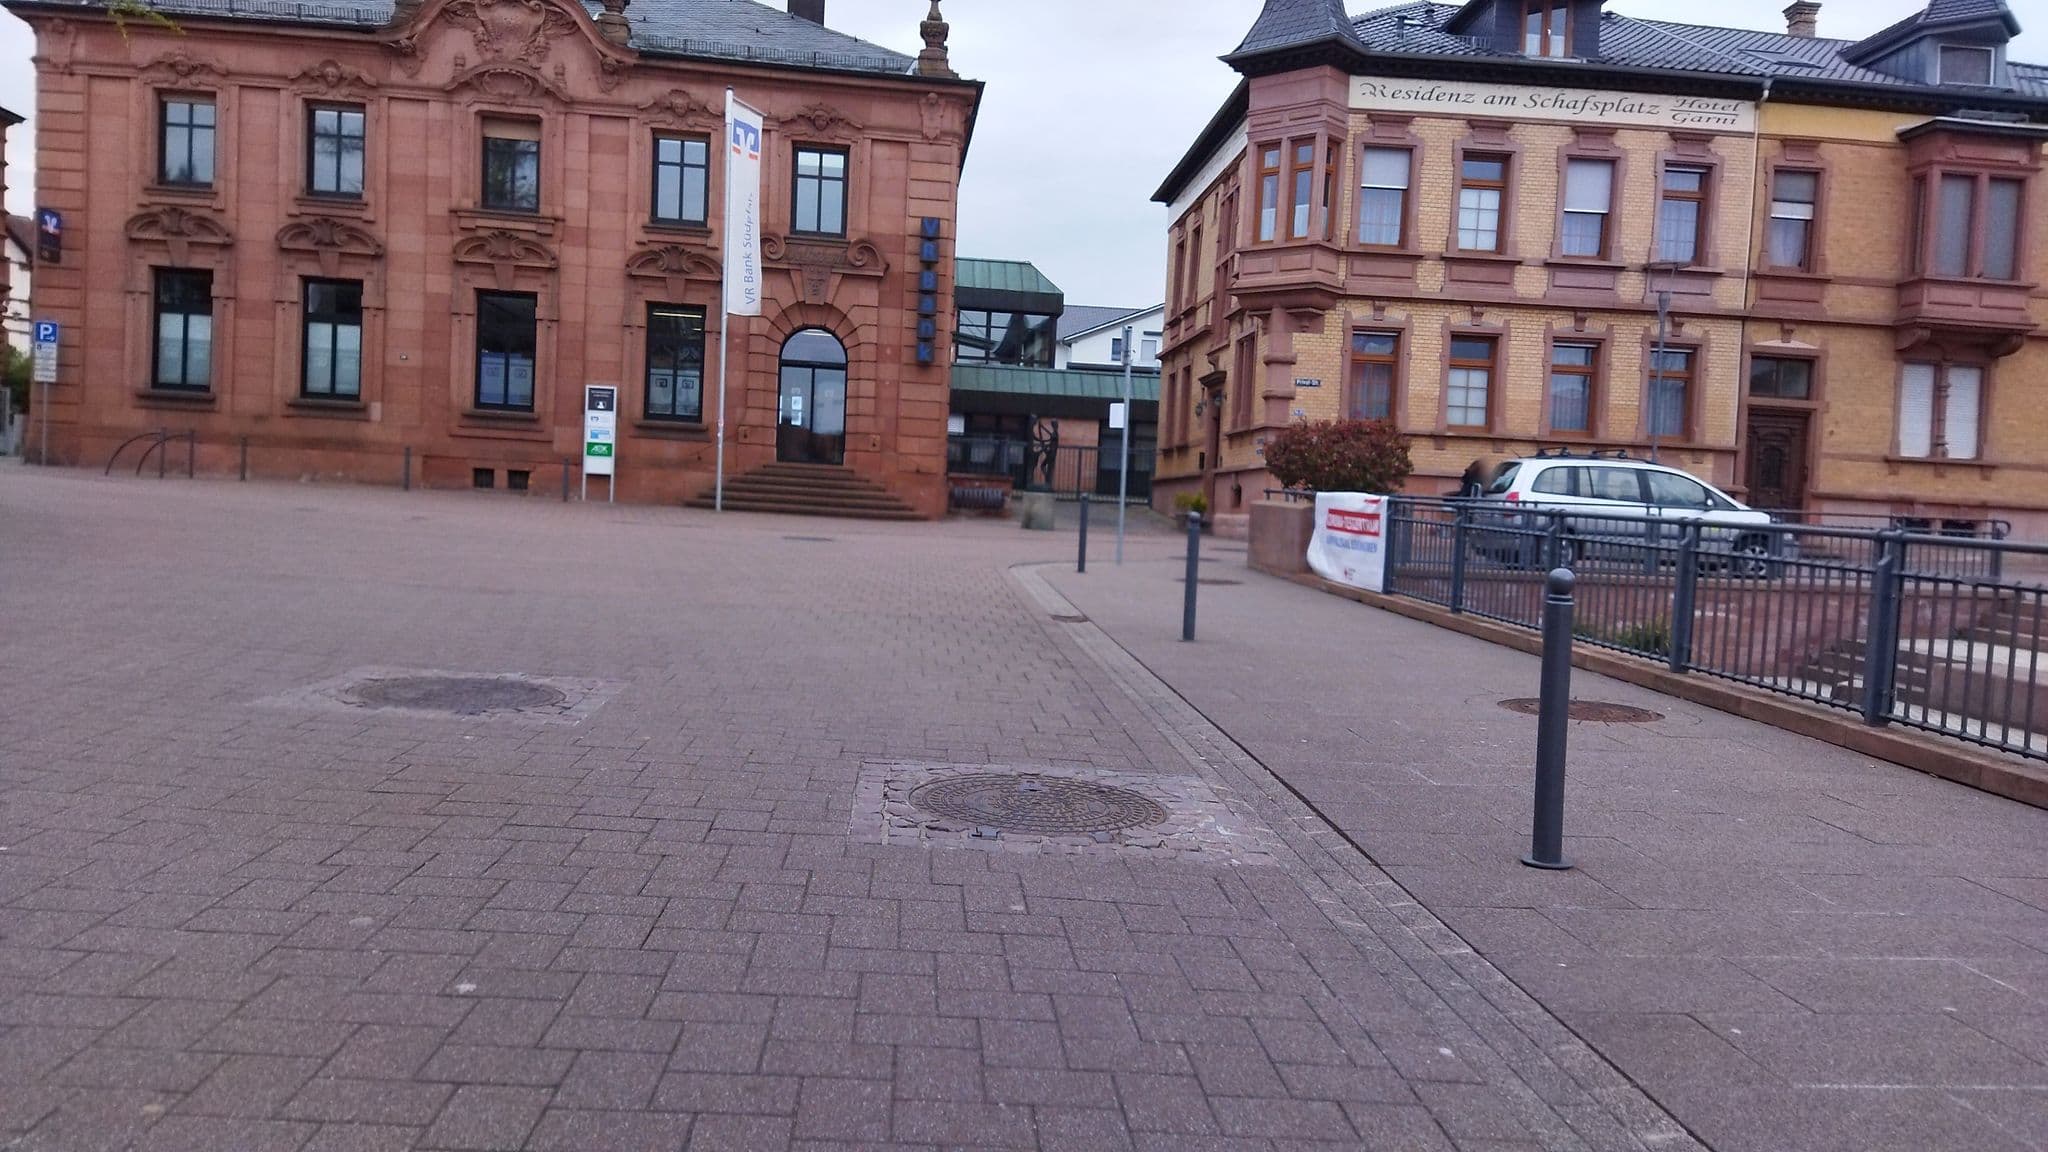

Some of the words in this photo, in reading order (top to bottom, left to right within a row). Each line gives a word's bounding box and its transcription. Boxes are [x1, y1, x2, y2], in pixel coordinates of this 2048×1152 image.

[1359, 82, 1476, 104] Residenz
[1483, 94, 1518, 106] am
[1523, 92, 1661, 117] Schafsplatz
[1674, 97, 1744, 112] Hotel
[1671, 112, 1738, 125] Garni
[921, 217, 940, 262] VR
[743, 252, 754, 283] Bank
[745, 287, 756, 305] VR
[40, 324, 53, 340] P
